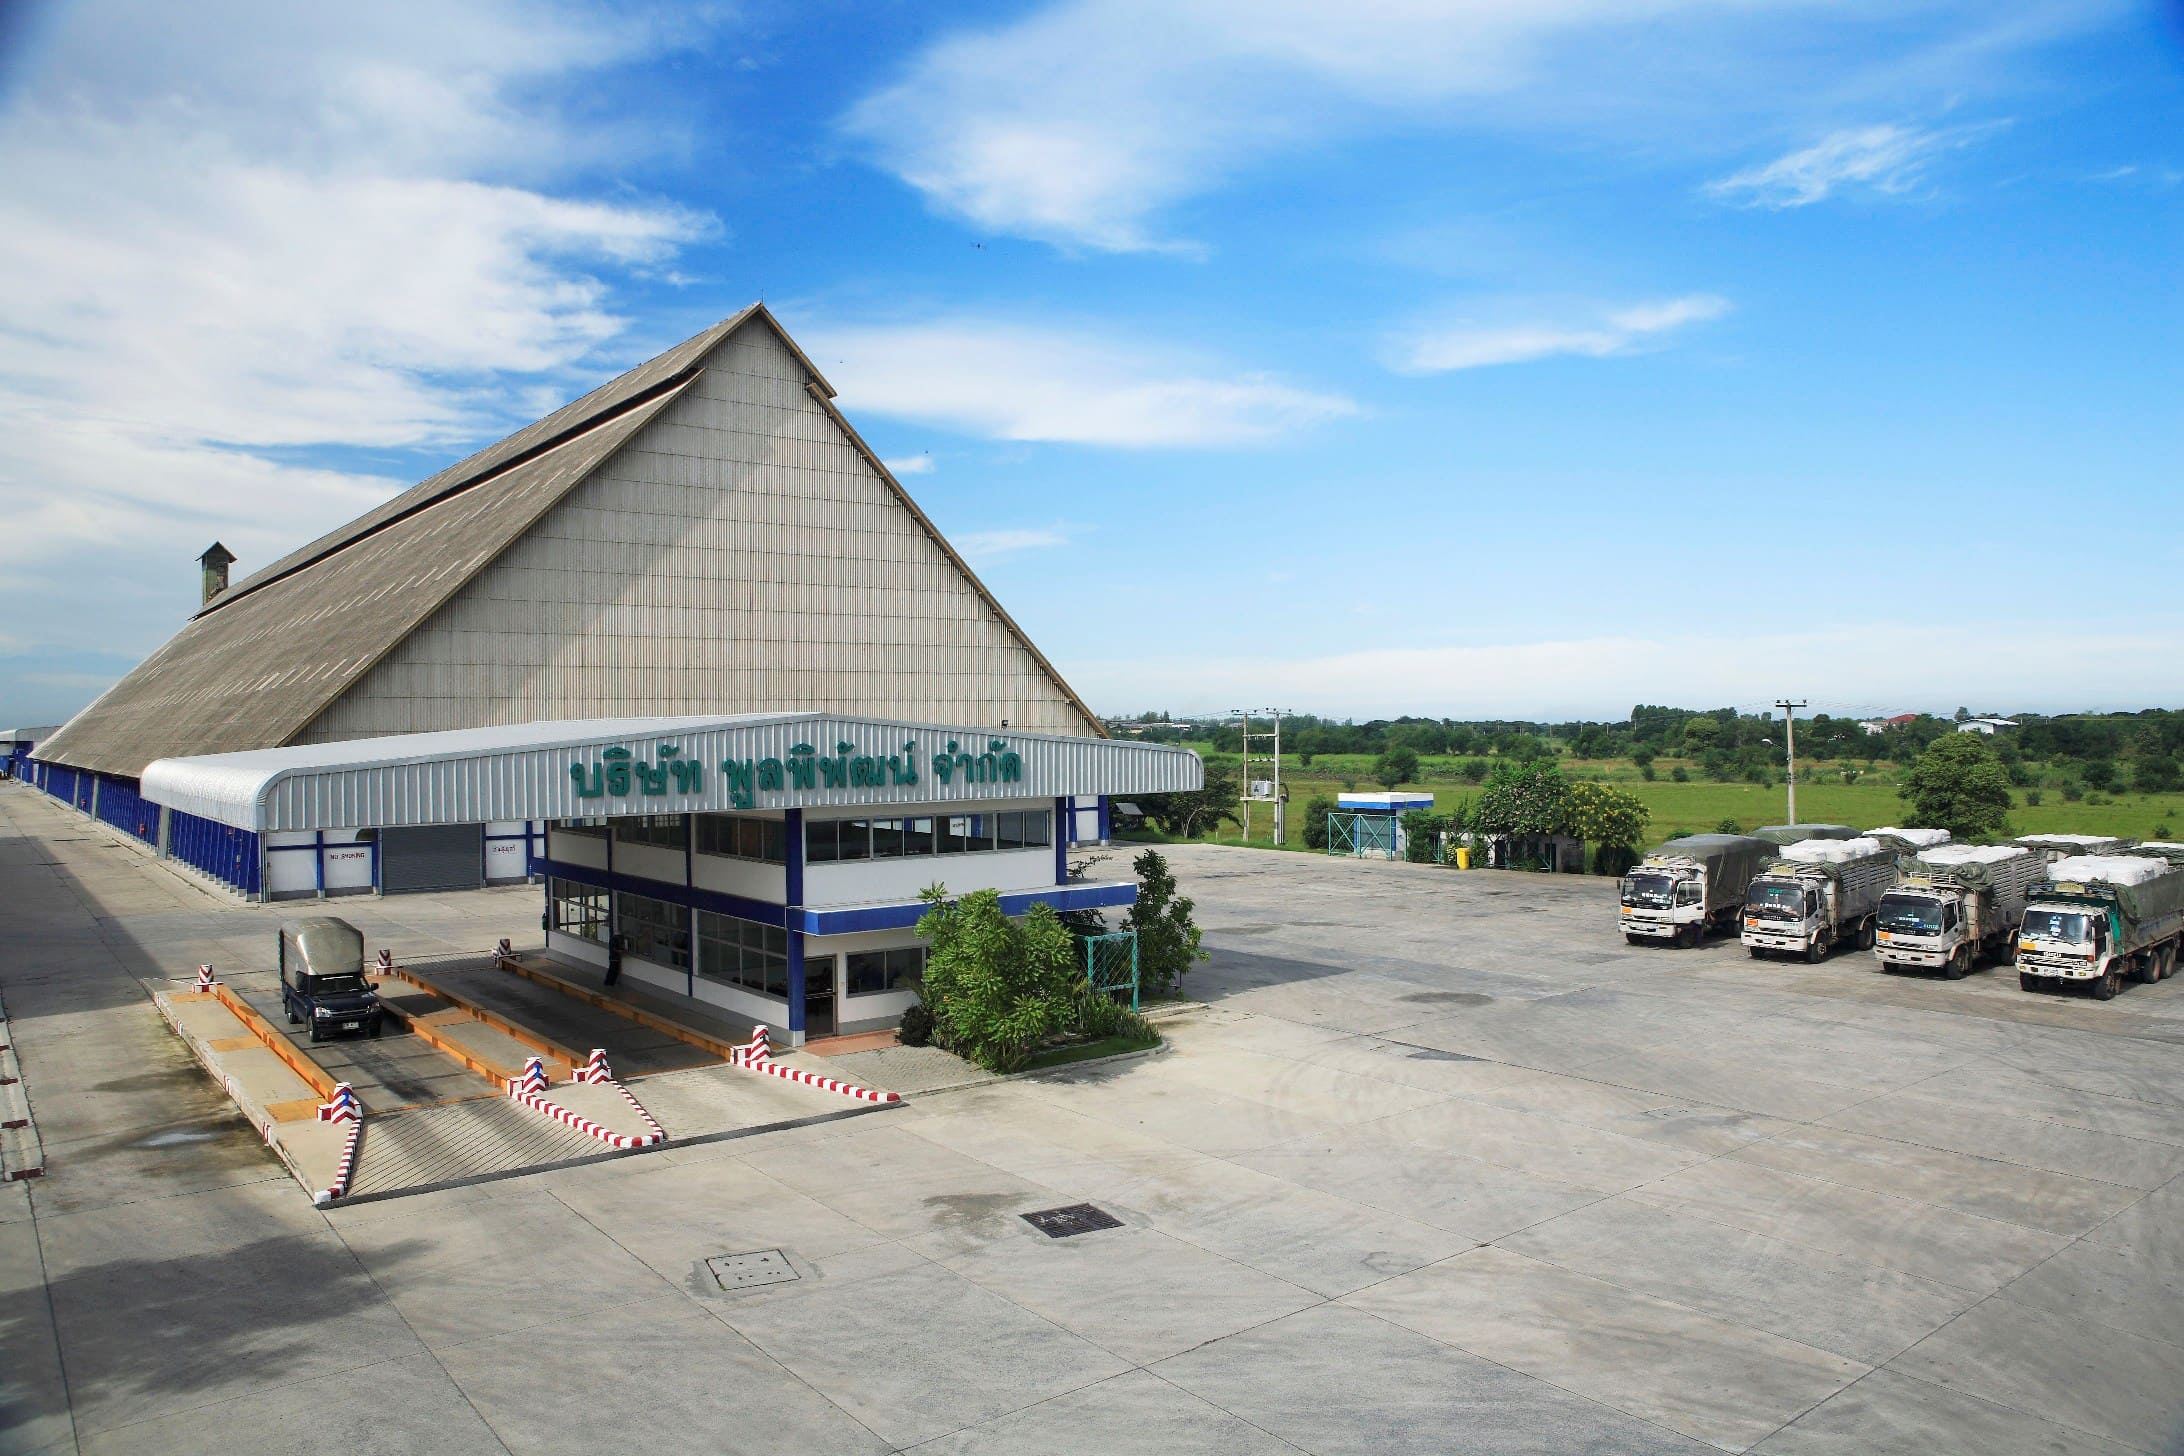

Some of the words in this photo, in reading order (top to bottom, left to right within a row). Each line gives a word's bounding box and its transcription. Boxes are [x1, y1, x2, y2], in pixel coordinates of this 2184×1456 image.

[570, 744, 702, 798] บริษัท
[722, 740, 919, 808] พูลพิพัฒน์
[932, 740, 1022, 785] จำกัด
